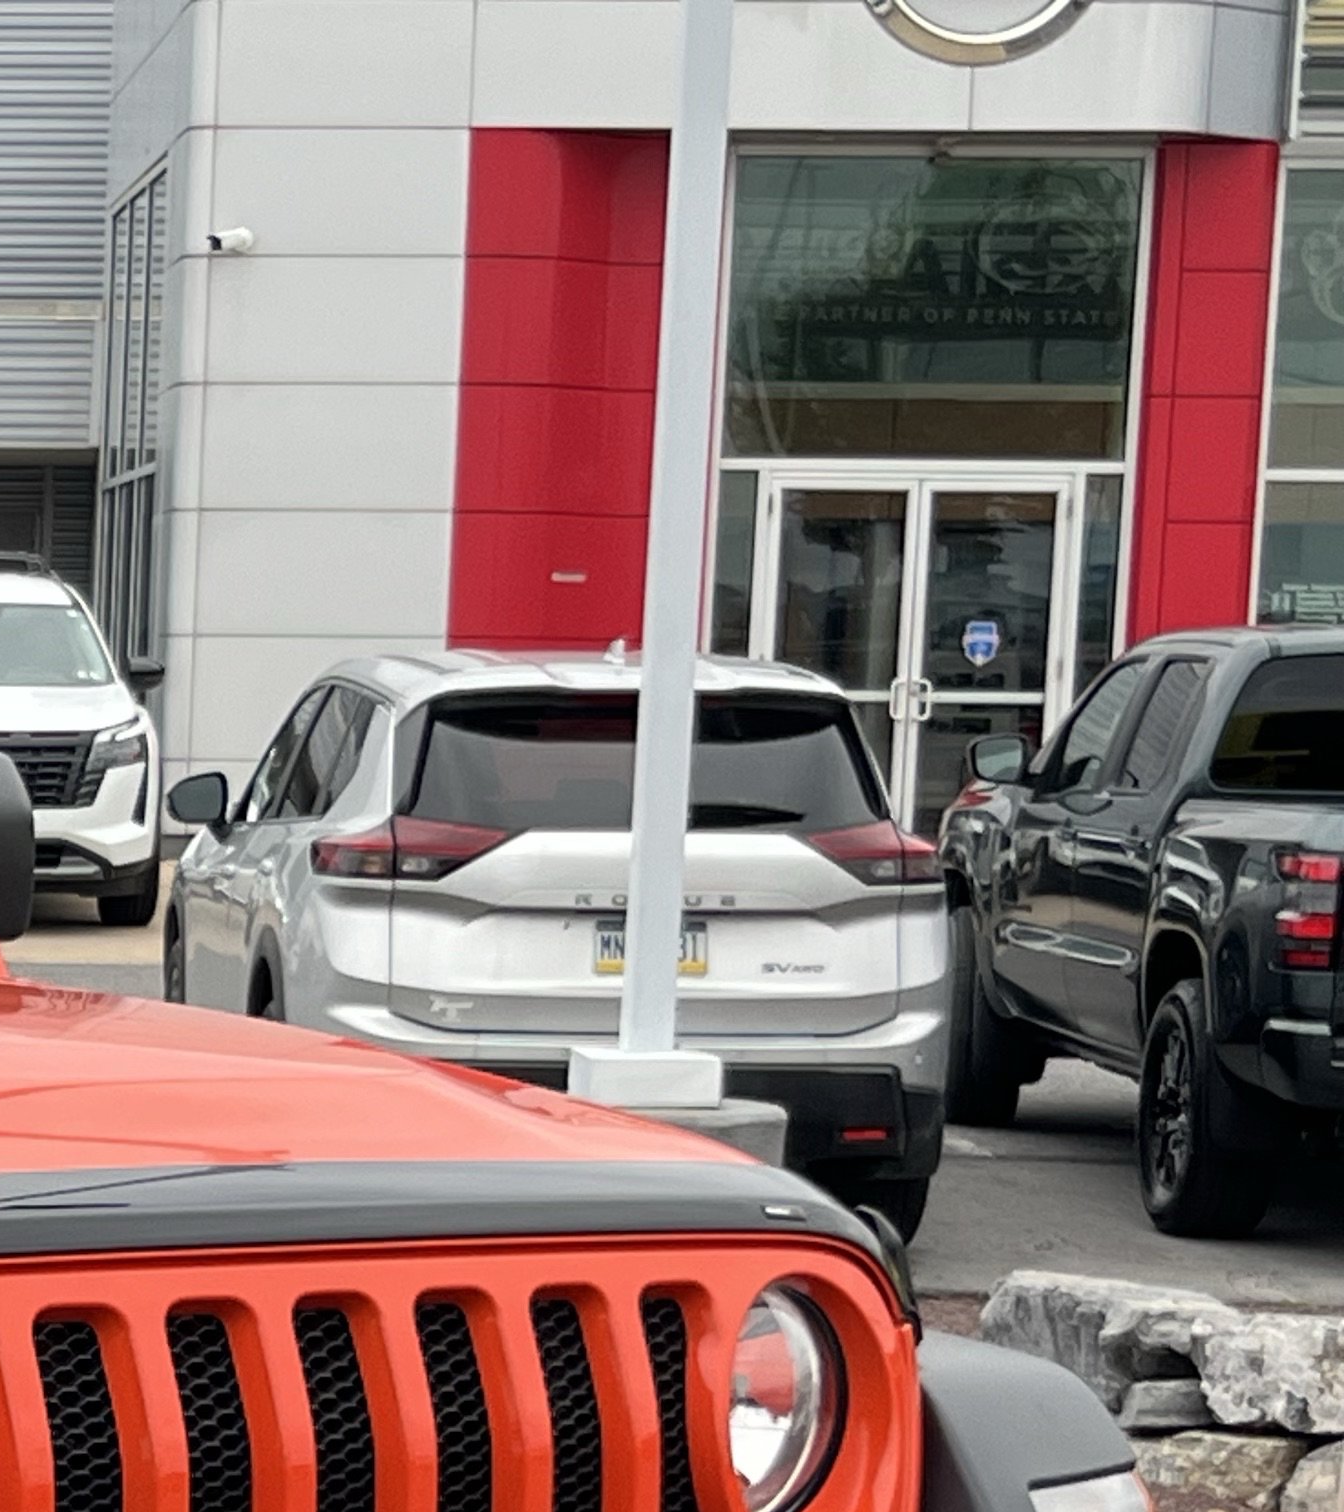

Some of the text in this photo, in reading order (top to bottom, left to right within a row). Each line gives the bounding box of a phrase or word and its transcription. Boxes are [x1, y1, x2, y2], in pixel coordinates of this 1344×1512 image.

[798, 305, 912, 324] PARTNER
[923, 306, 954, 323] OF
[965, 305, 1032, 324] PENN
[575, 892, 737, 907] ROUE
